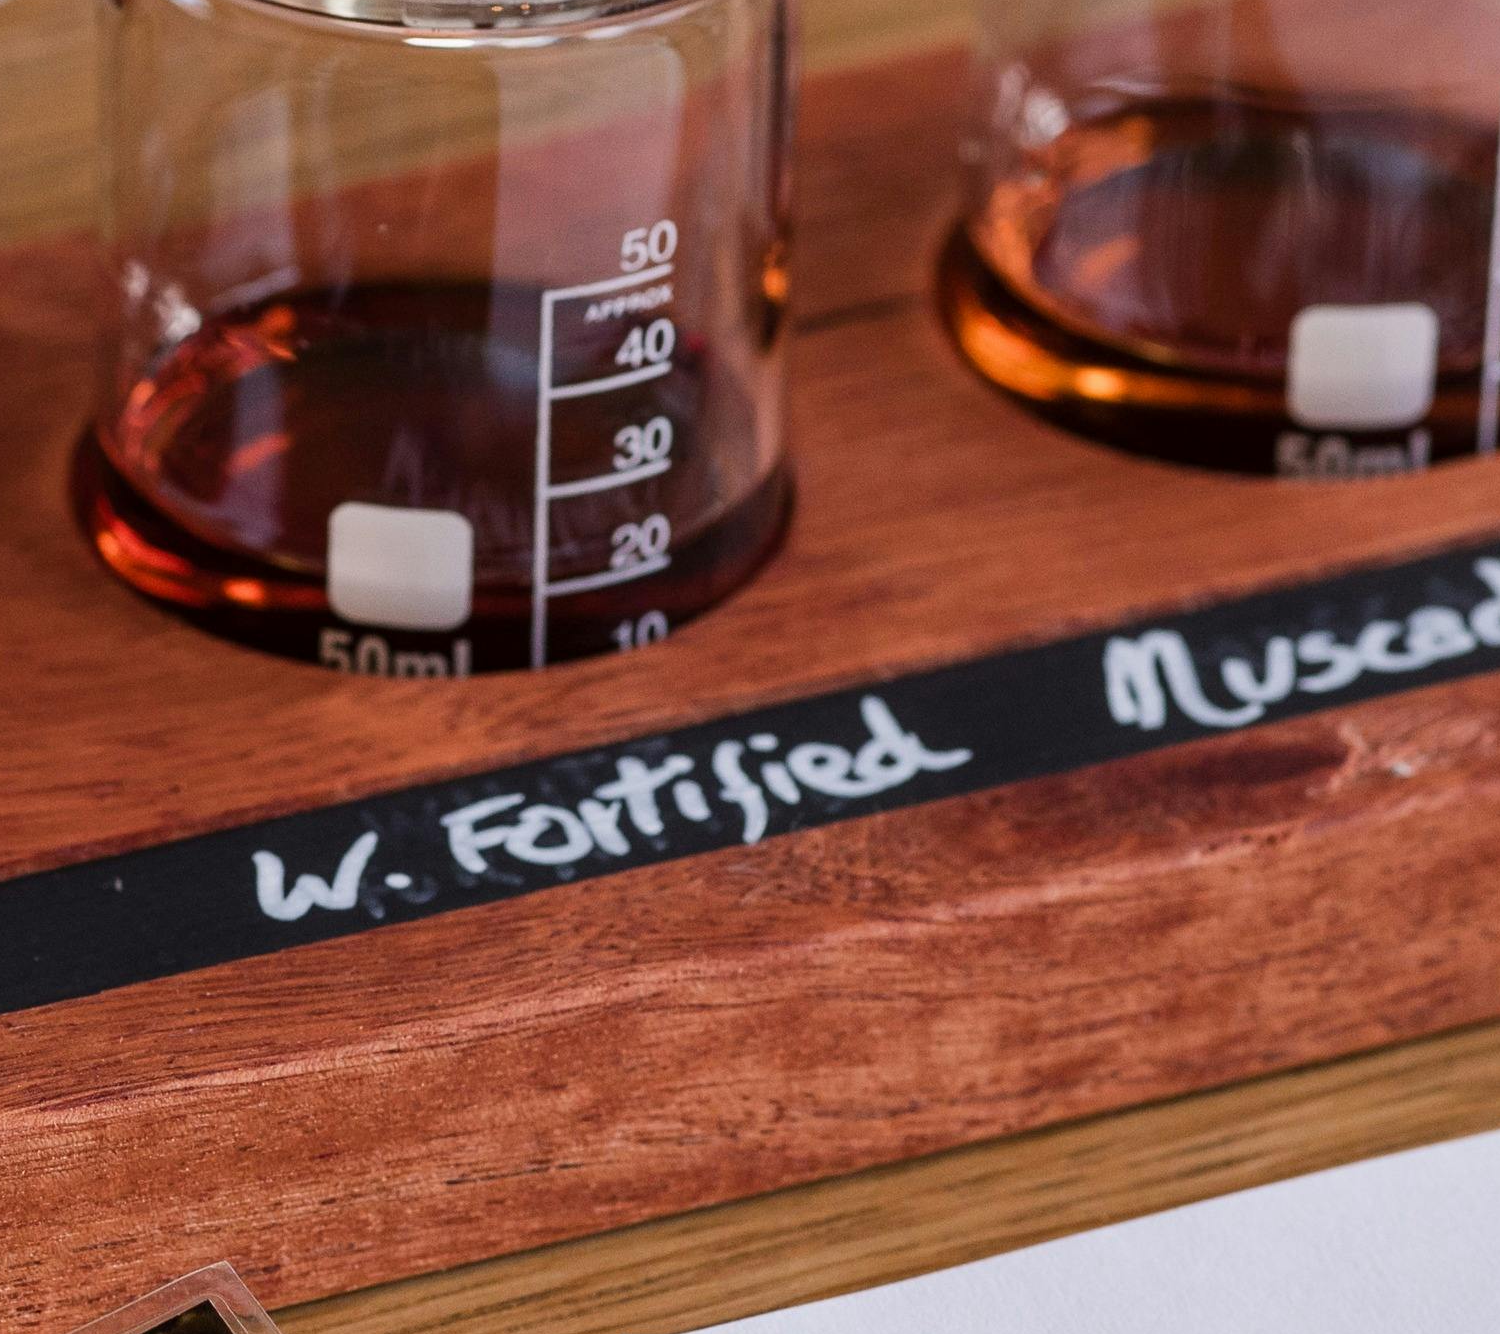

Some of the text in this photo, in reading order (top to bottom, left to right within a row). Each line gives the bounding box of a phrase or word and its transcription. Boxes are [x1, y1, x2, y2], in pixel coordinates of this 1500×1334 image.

[620, 220, 677, 273] 50
[615, 319, 675, 368] 40
[614, 417, 673, 468] 30
[610, 514, 671, 568] 20
[254, 828, 410, 922] W.
[443, 695, 974, 876] Fortified
